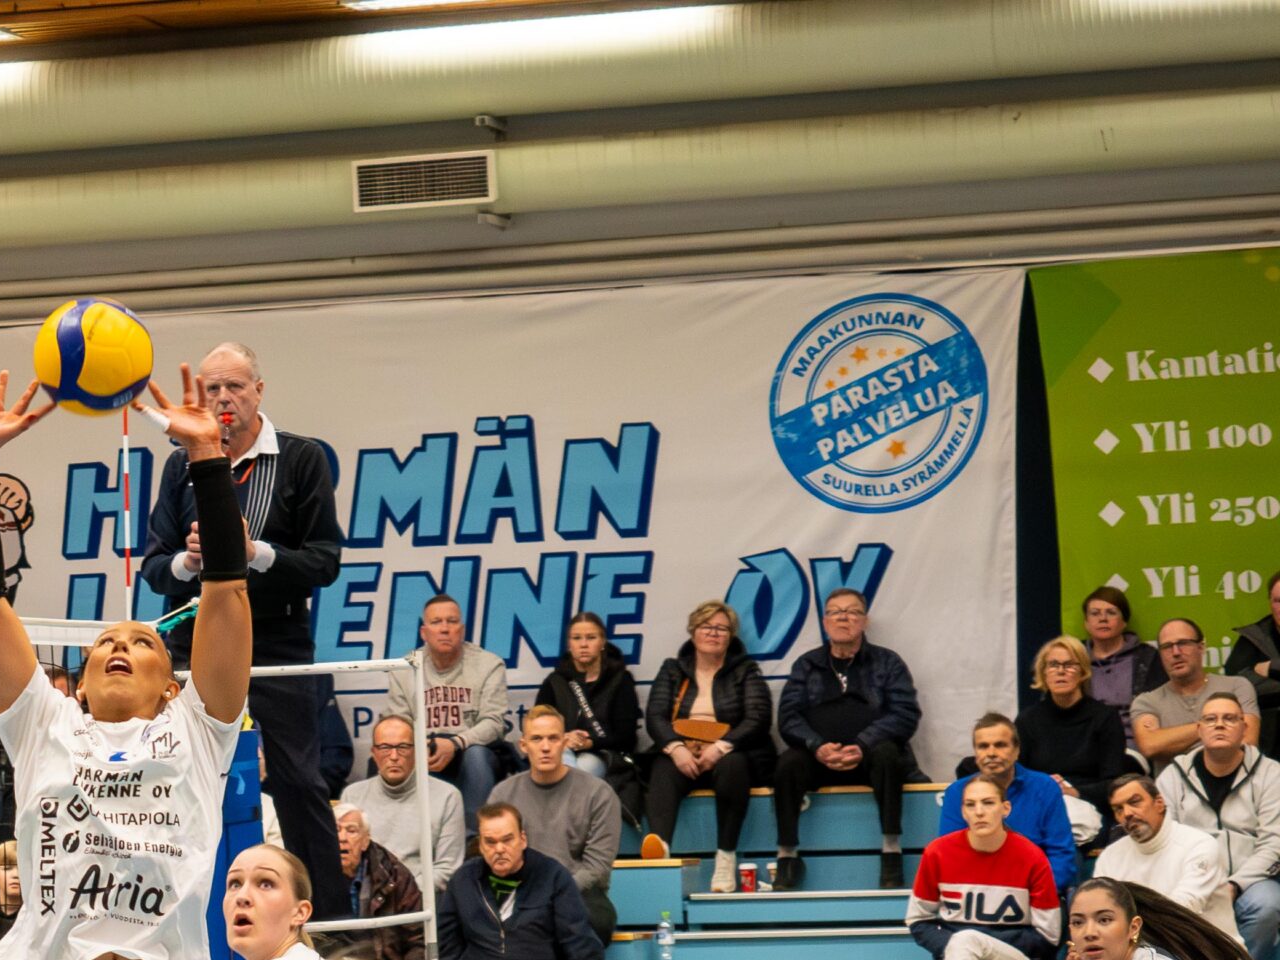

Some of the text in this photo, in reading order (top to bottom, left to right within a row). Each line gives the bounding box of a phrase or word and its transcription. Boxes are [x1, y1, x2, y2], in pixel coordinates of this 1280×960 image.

[792, 311, 925, 378] MAAKUNNAN
[1125, 341, 1280, 383] Kantati
[811, 353, 940, 427] PARASTA
[816, 380, 960, 462] PALVELUA
[1132, 420, 1273, 453] Yli 100
[821, 405, 975, 497] SUURELLA SYRÄMMELLÄ
[62, 414, 660, 561] HMÄN
[1137, 492, 1280, 527] Yli 250
[1142, 565, 1202, 598] Yli
[423, 685, 472, 705] PERDRY
[426, 705, 461, 728] 1979
[40, 821, 57, 916] MELTEX
[69, 864, 166, 917] Atria
[941, 890, 1024, 922] FILA
